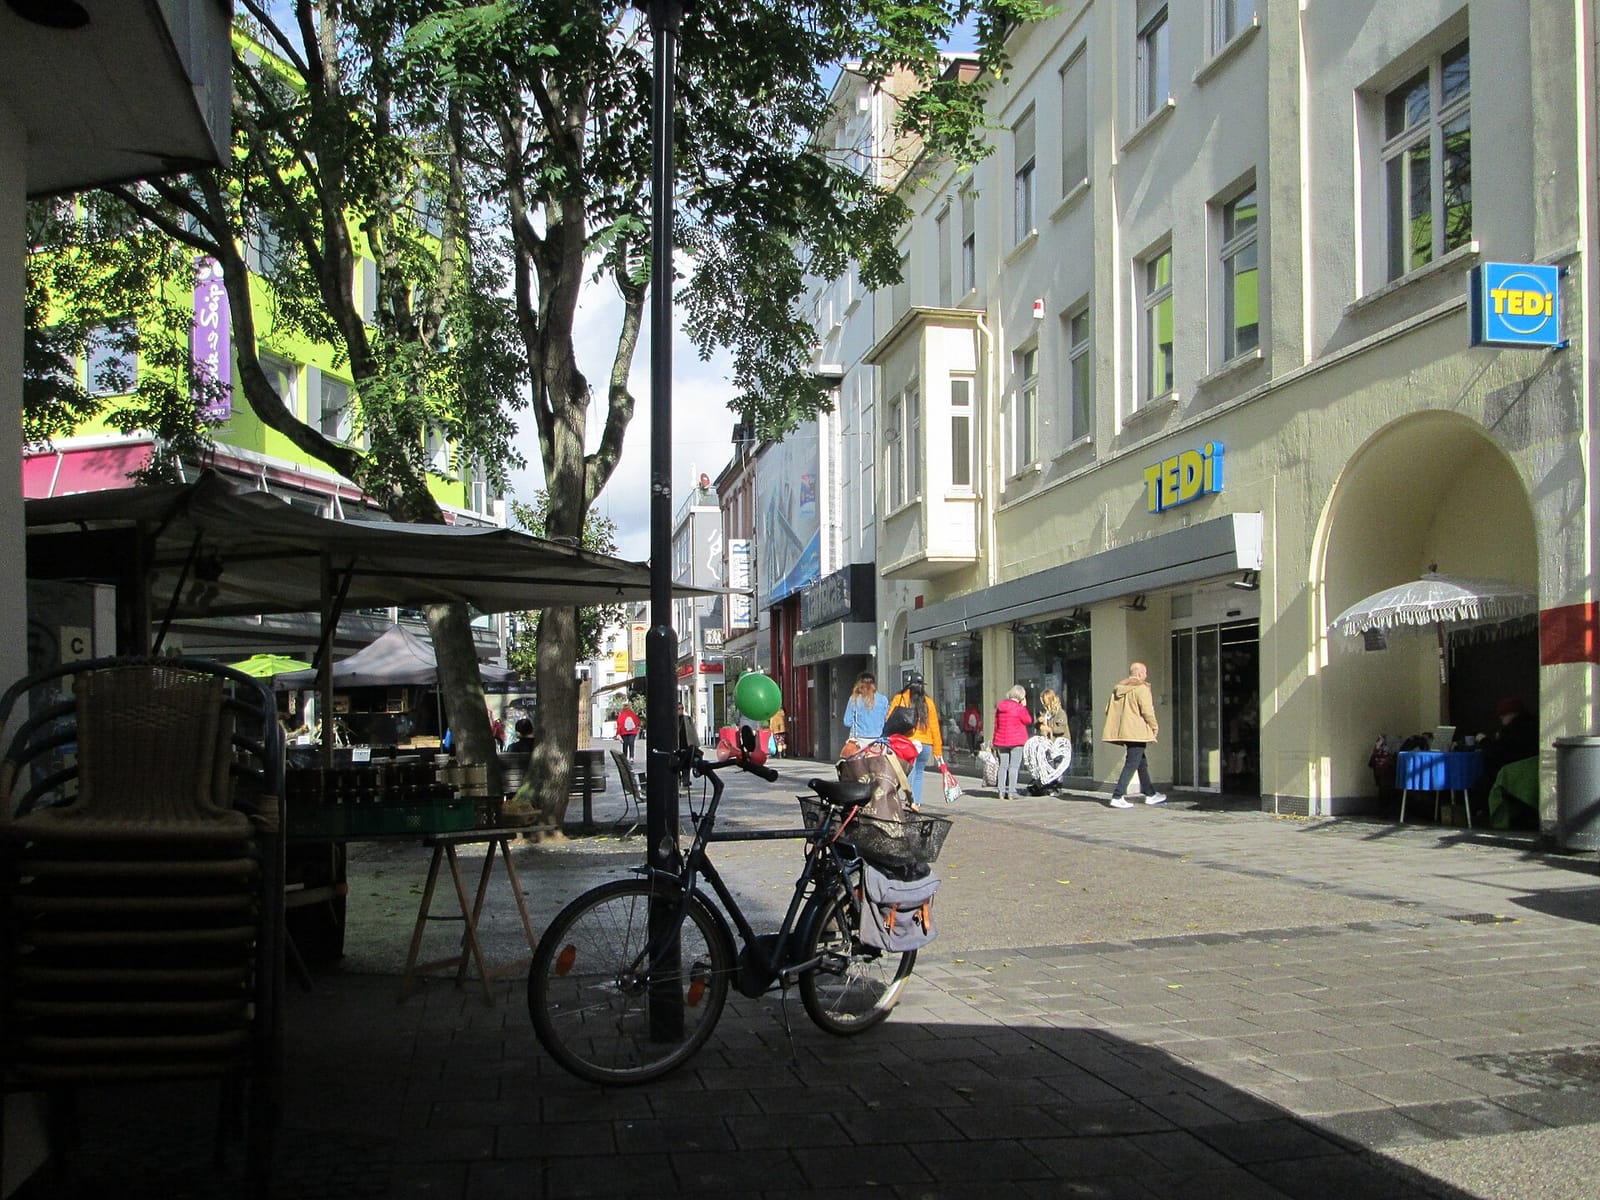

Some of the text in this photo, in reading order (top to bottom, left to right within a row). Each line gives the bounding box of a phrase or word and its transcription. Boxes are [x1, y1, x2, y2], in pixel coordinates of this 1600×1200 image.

[200, 284, 225, 329] Seip
[1490, 289, 1553, 317] TEDi
[1144, 441, 1220, 513] TEDi
[71, 637, 84, 654] C
